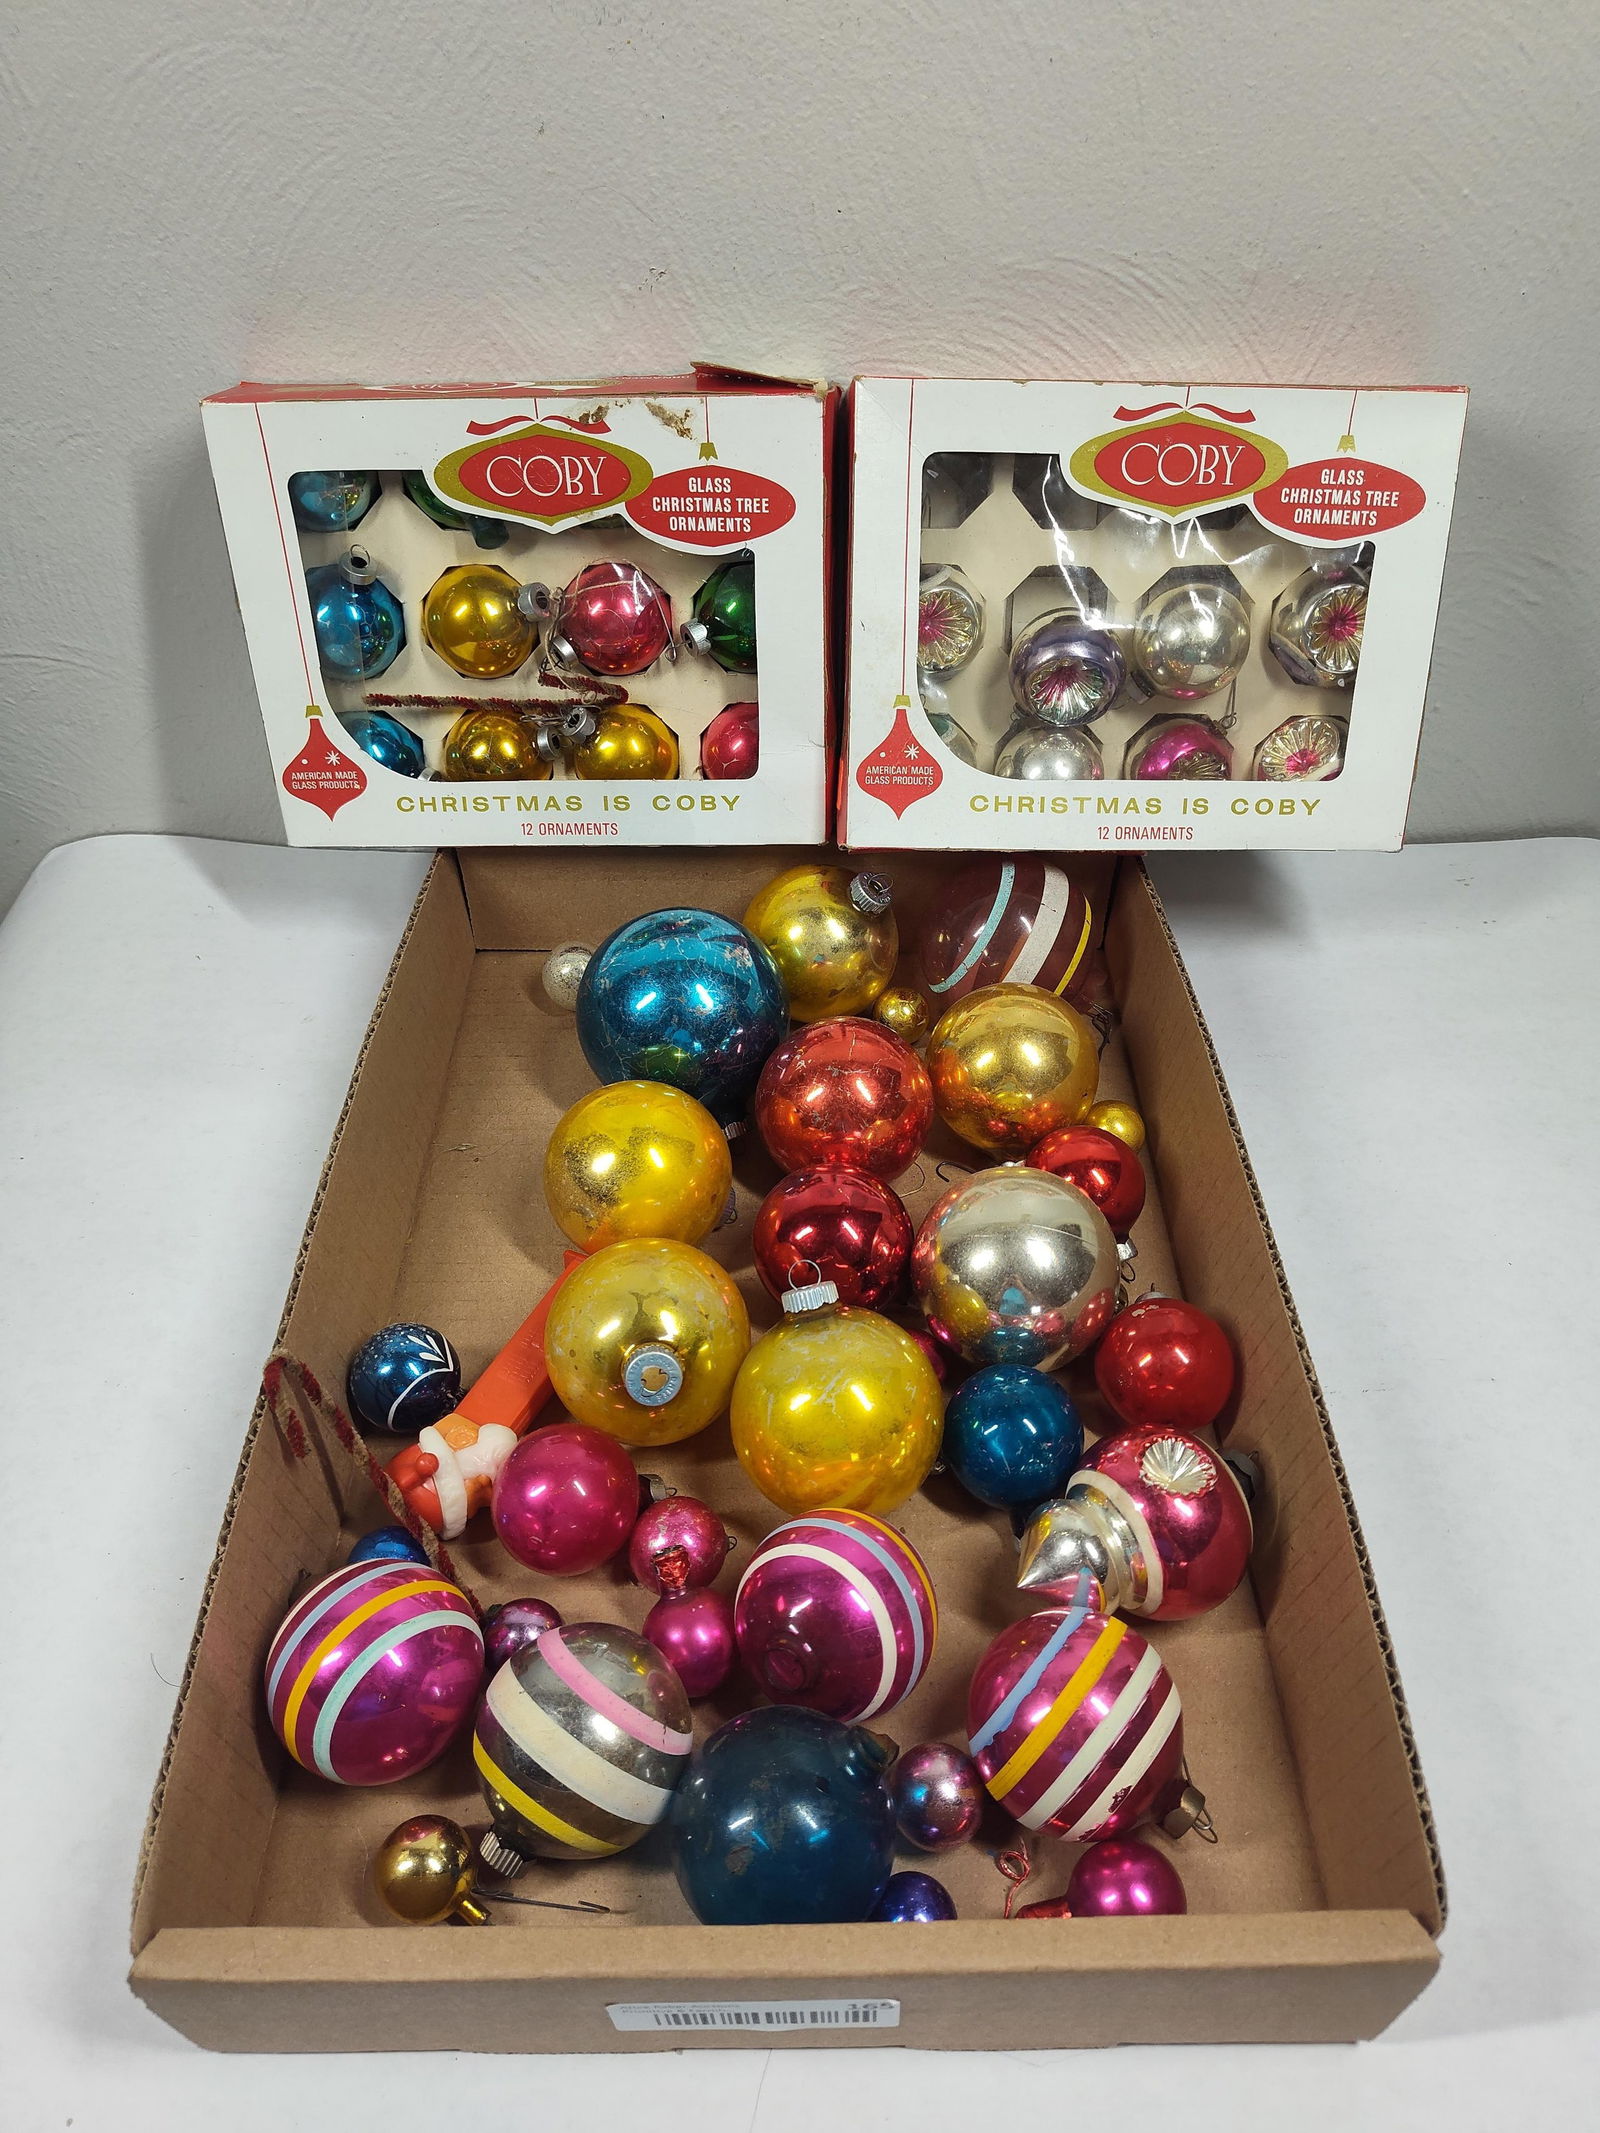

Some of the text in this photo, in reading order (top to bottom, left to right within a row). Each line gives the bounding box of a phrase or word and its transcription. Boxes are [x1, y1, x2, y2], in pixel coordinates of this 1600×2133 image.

[1121, 443, 1245, 486] COBY
[486, 455, 607, 497] COBY
[1320, 469, 1364, 485] GLASS
[688, 477, 731, 493] GLASS
[652, 497, 769, 513] CHRISTMAS TREE
[1281, 488, 1399, 507] CHRISTMAS TREE
[669, 517, 751, 532] ORNAMENTS
[1293, 508, 1378, 526] ORNAMENTS
[291, 771, 358, 780] AMERICAN MADE
[866, 766, 934, 775] AMERICAN MADE
[292, 780, 359, 790] GLASS PRODUCTS
[865, 776, 934, 785] GLASS PRODUCTS
[396, 795, 741, 813] CHRISTMAS IS COBY
[969, 795, 1321, 817] CHRISTMAS IS COBY
[520, 822, 619, 837] 12 ORNAMENTS
[1097, 825, 1194, 841] 12 ORNAMENTS
